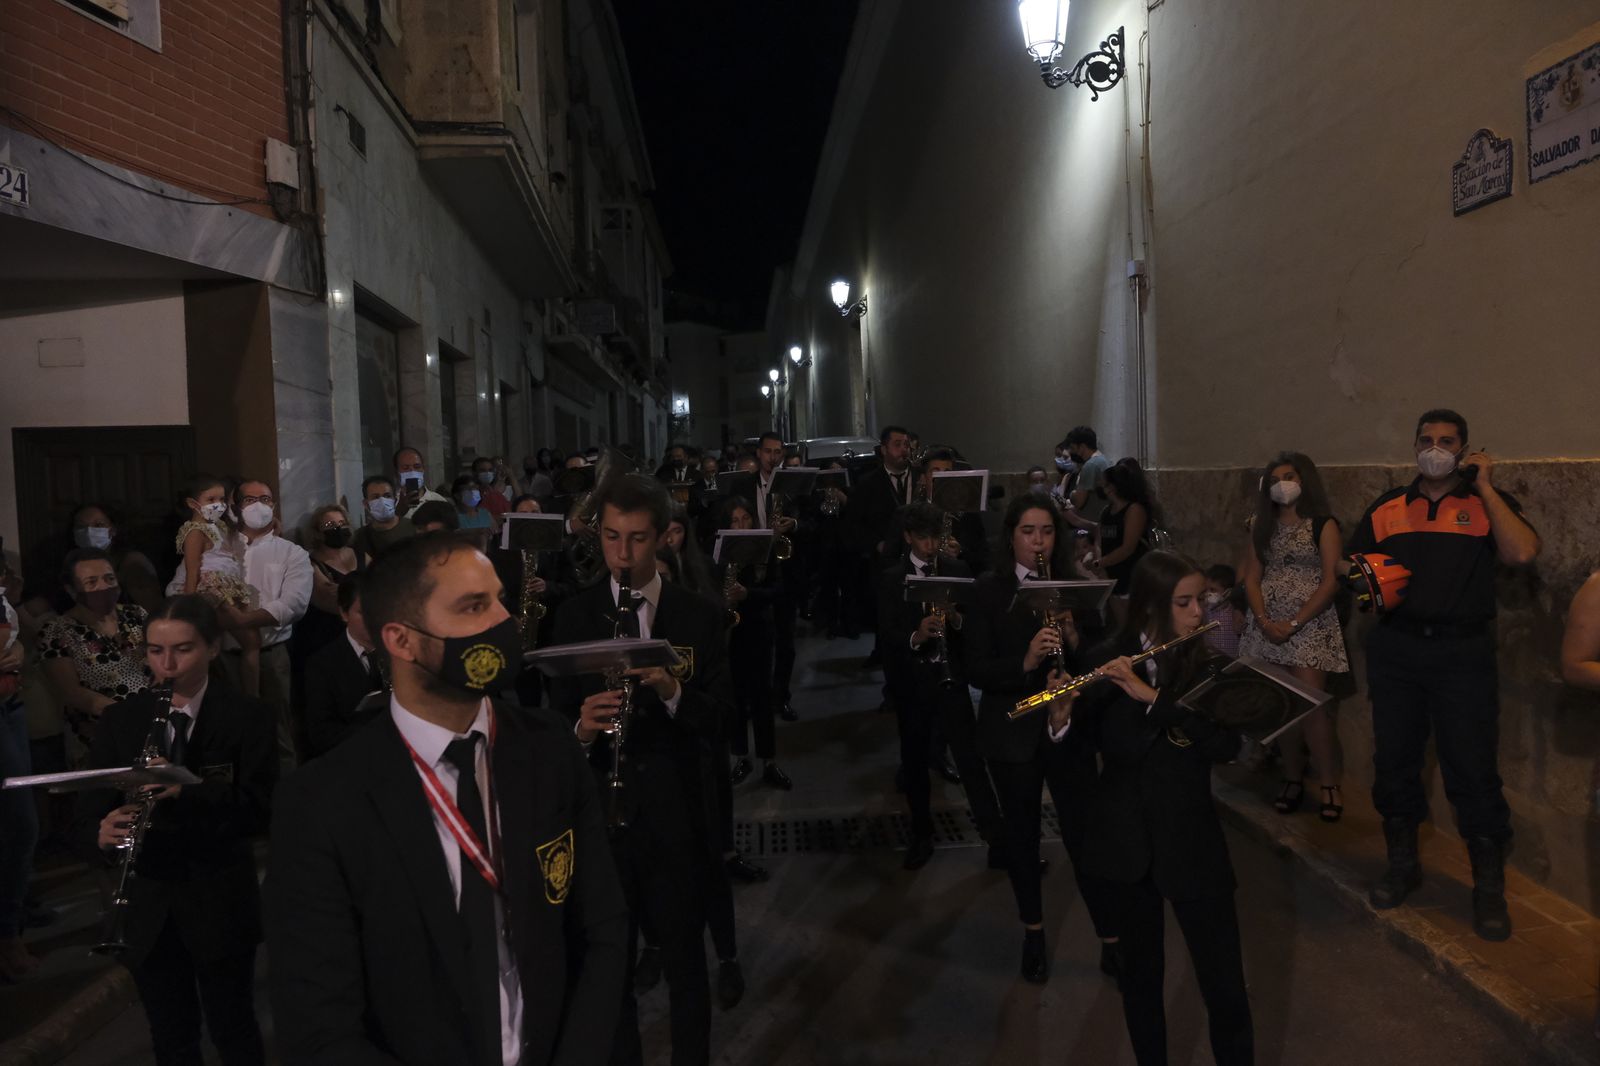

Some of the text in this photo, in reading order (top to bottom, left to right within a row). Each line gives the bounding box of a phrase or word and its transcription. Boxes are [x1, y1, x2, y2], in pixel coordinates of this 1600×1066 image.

[1533, 135, 1580, 168] SALVADOR
[0, 166, 27, 203] 24
[1459, 183, 1477, 201] San
